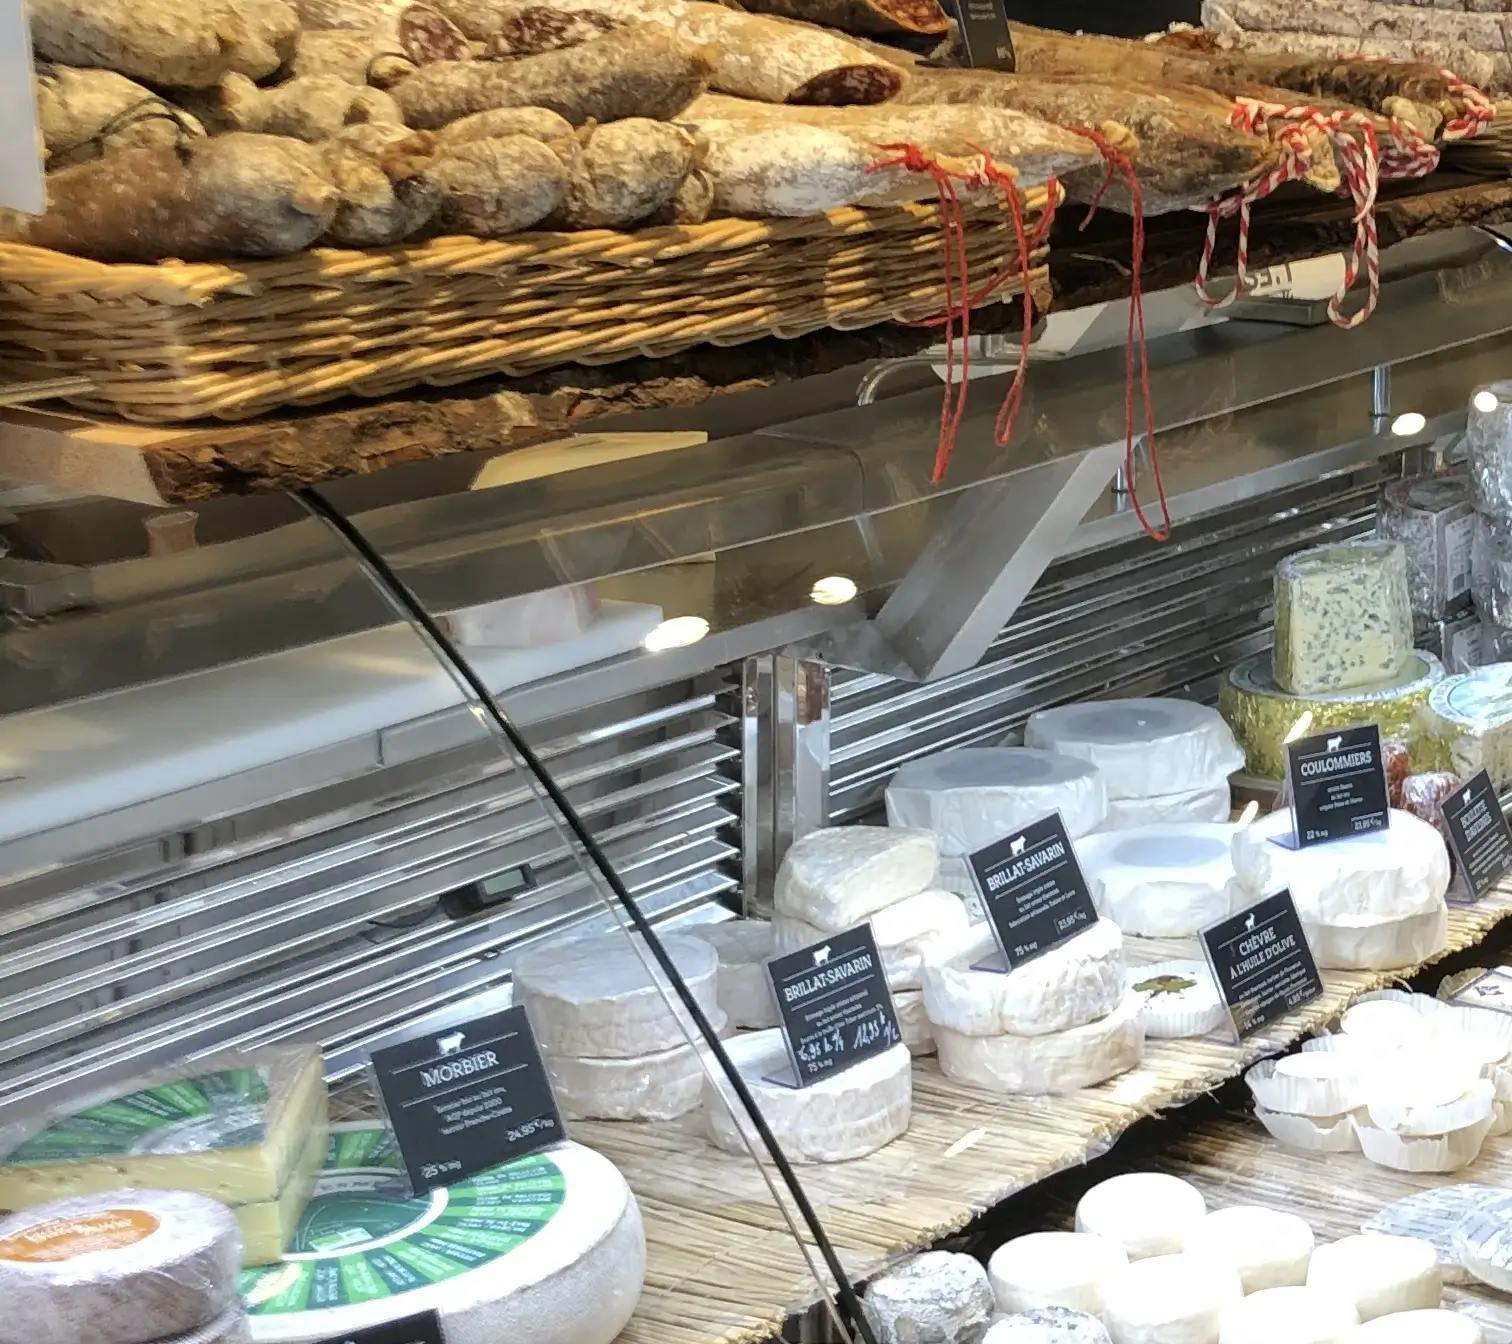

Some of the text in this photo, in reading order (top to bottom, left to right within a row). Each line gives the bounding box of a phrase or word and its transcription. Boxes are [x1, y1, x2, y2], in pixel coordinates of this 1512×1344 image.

[1300, 748, 1372, 778] COULOMMIERS
[986, 840, 1065, 892] BRILLAT-SAVARIN
[1236, 951, 1265, 975] L'HUILE
[1264, 934, 1296, 959] D'OLIVE
[1237, 924, 1276, 956] CHÈVRE
[783, 953, 873, 1002] BRILLAT-SAVARIN
[420, 1047, 499, 1088] MORBIER
